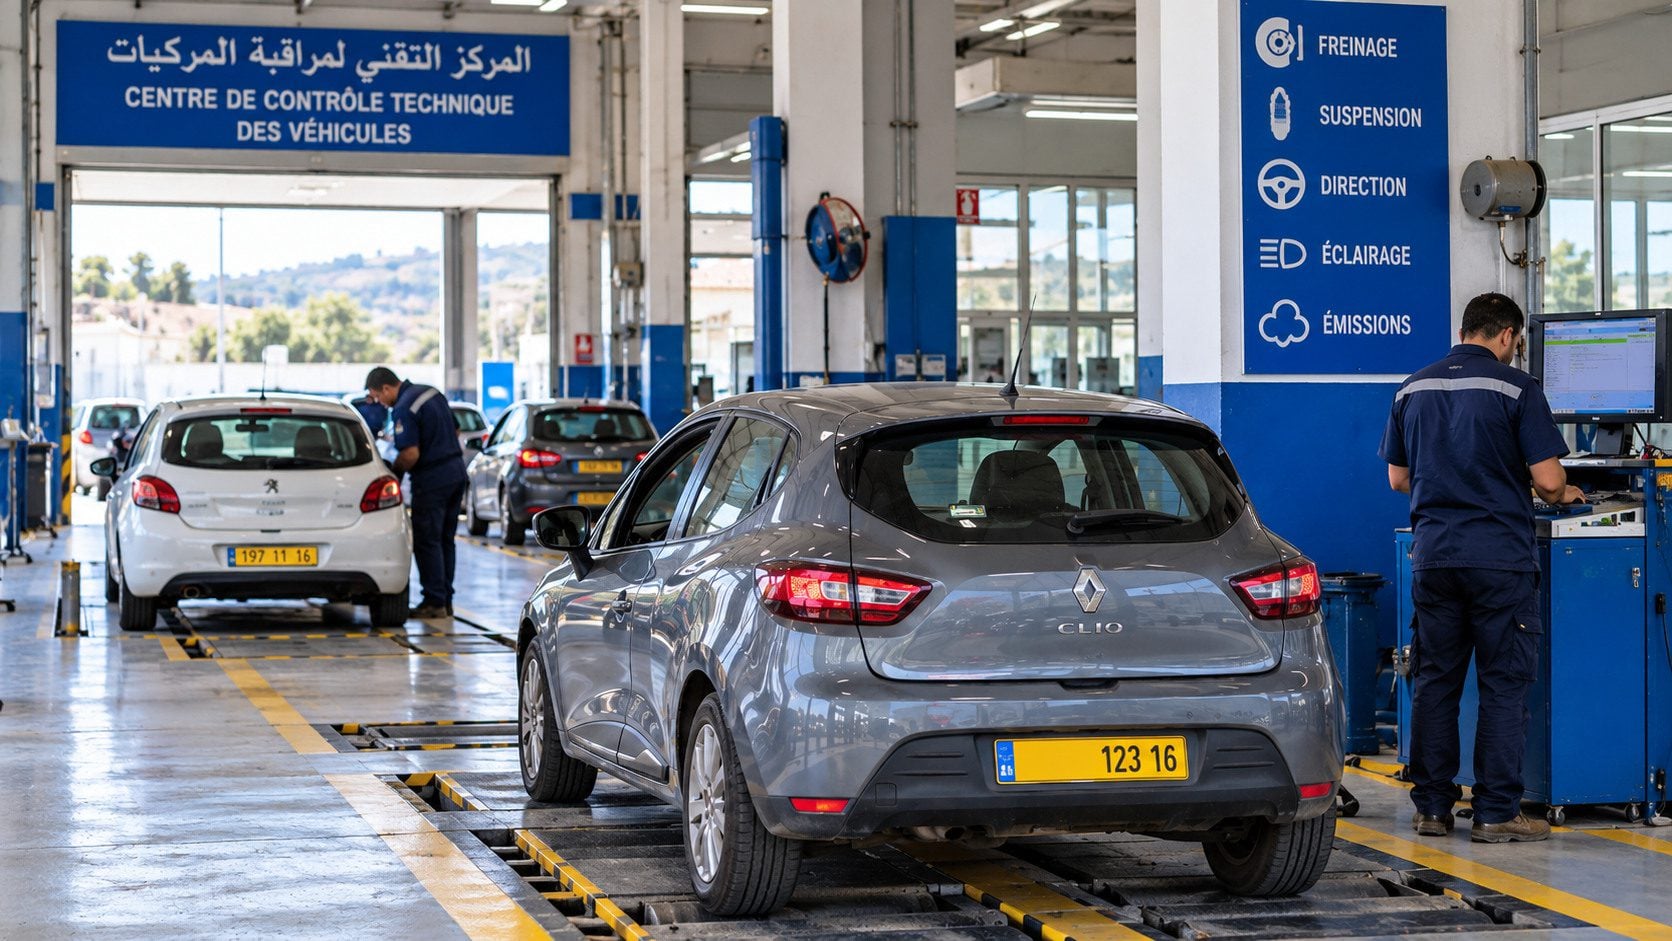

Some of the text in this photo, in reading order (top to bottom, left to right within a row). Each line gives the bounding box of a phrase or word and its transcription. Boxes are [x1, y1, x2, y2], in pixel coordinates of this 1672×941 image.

[249, 36, 346, 76] لمراقبة
[1318, 36, 1398, 58] FREINAGE
[355, 42, 441, 83] التقني
[450, 45, 532, 80] المركز
[125, 86, 514, 116] CENTRE DE CONTRÔLE TECHNIQUE
[1319, 105, 1422, 128] SUSPENSION
[237, 117, 412, 145] DES VÉHICULES
[1321, 175, 1407, 197] DIRECTION
[1322, 240, 1411, 266] ÉCLAIRAGE
[1323, 309, 1412, 335] ÉMISSIONS
[241, 549, 311, 563] 197 11 16
[1058, 622, 1123, 634] CLIO
[1101, 744, 1177, 773] 123 16
